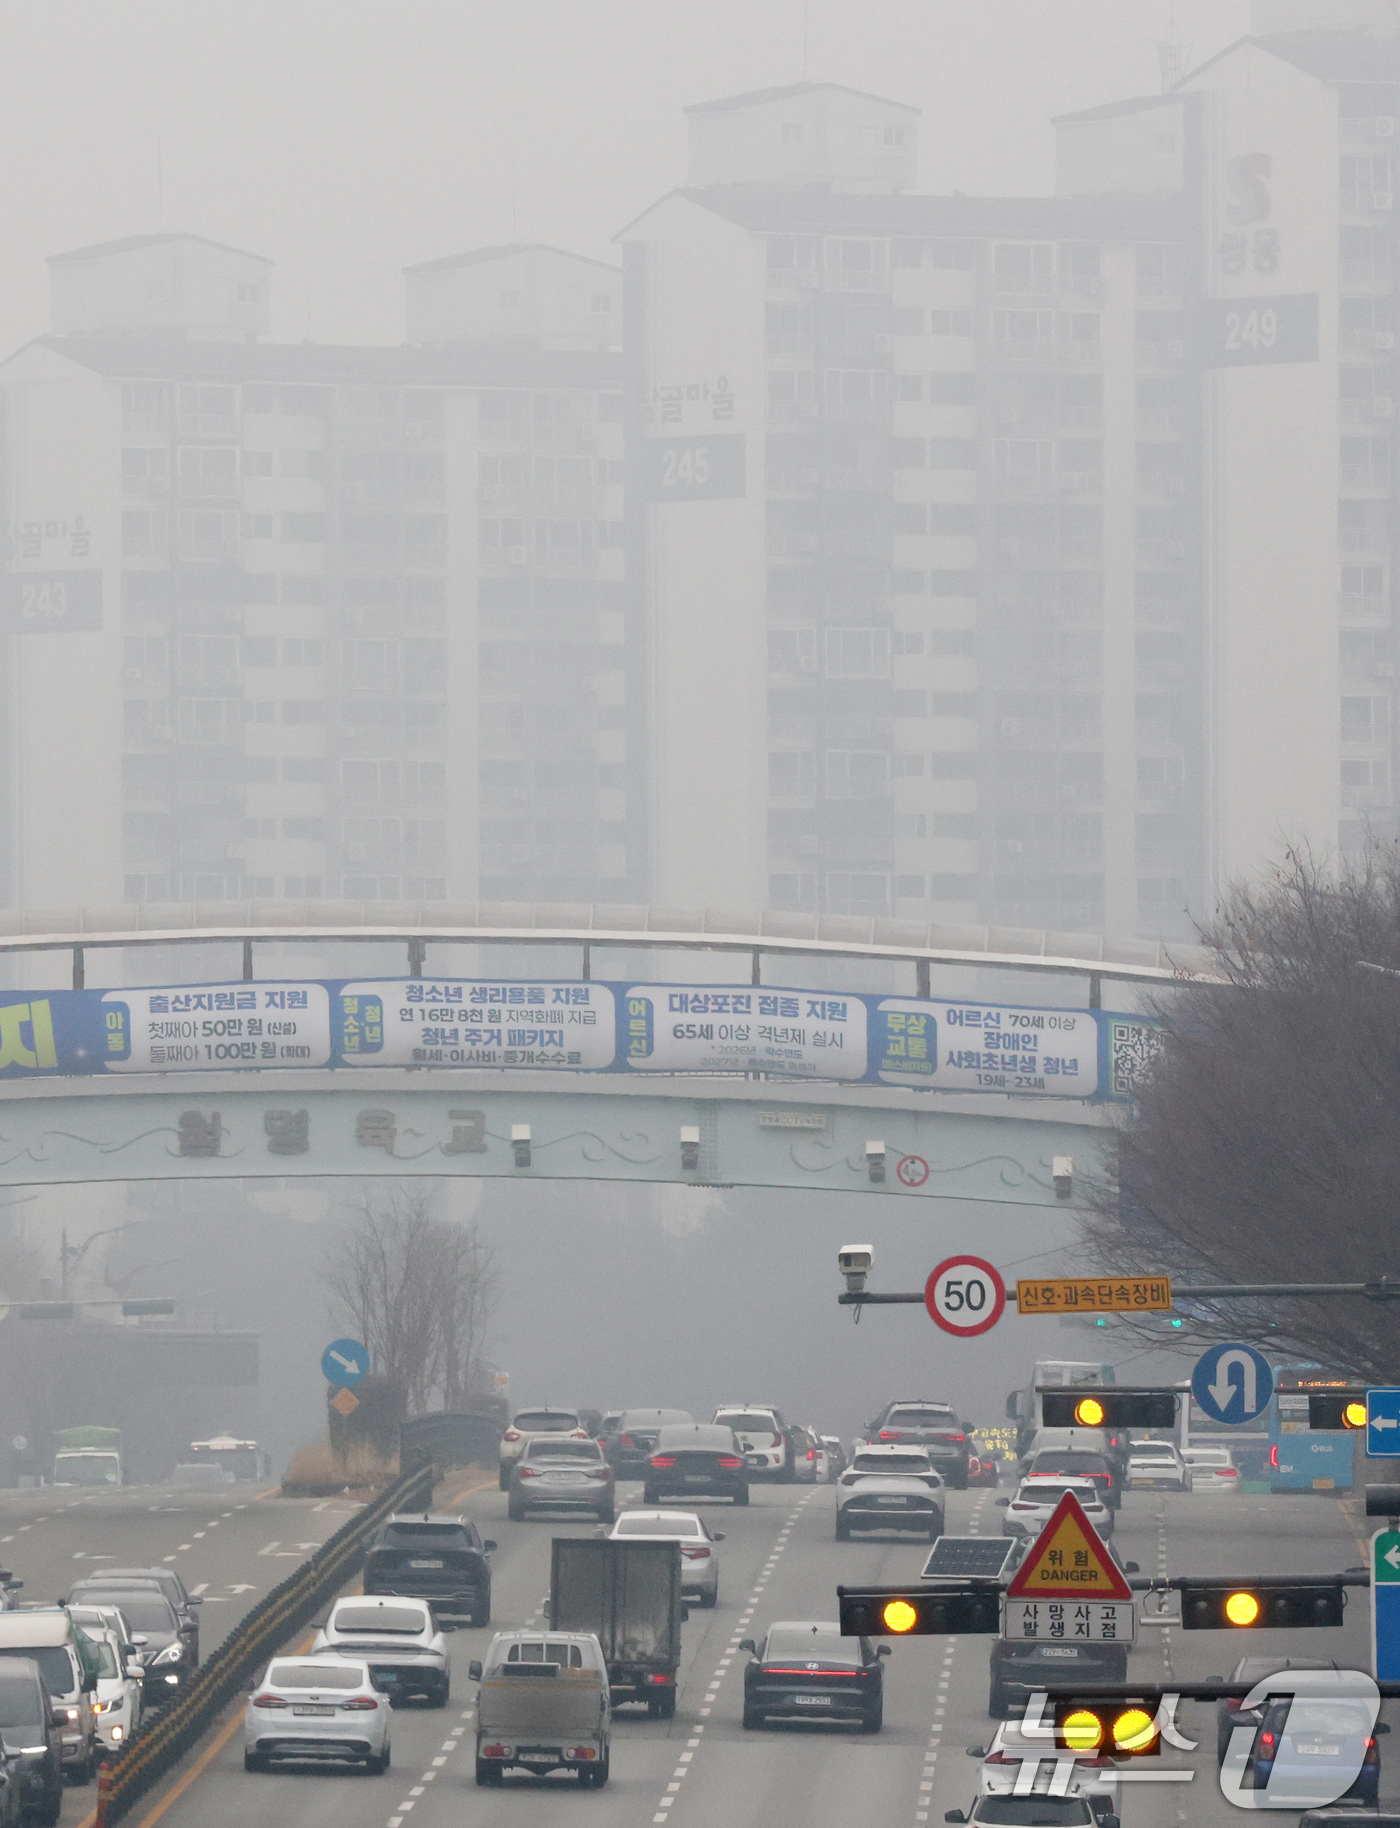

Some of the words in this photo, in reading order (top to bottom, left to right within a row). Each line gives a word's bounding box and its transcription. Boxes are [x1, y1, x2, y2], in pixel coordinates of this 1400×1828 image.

[1225, 308, 1277, 350] 249
[662, 446, 709, 486] 245
[22, 581, 67, 619] 243
[148, 991, 257, 1014] 출산지원금
[264, 990, 308, 1010] 지원
[405, 984, 463, 1004] 청소년
[469, 985, 545, 1005] 생리용품
[552, 987, 590, 1006] 지원
[399, 1008, 414, 1022] 연
[418, 1008, 455, 1023] 16만
[505, 1008, 564, 1025] 지역화폐
[567, 1009, 597, 1025] 지급
[668, 993, 752, 1015] 대상포진
[758, 995, 799, 1018] 접종
[806, 1001, 848, 1022] 지원
[148, 1021, 198, 1040] 첫째아
[886, 1013, 927, 1035] 무상
[946, 1008, 1001, 1029] 어르신
[1008, 1014, 1045, 1029] 70세
[1048, 1015, 1076, 1031] 이상
[421, 1027, 460, 1046] 청년
[464, 1028, 502, 1048] 주거
[507, 1028, 564, 1048] 패키지
[672, 1023, 713, 1041] 65세
[718, 1024, 751, 1041] 이상
[757, 1025, 806, 1046] 격년제
[812, 1029, 844, 1049] 실시
[983, 1032, 1038, 1052] 장애인
[149, 1045, 199, 1064] 둘째아
[945, 1050, 1036, 1073] 사회초년생
[1042, 1056, 1079, 1076] 청년
[943, 1279, 986, 1312] 50
[1040, 1569, 1098, 1582] DANGER
